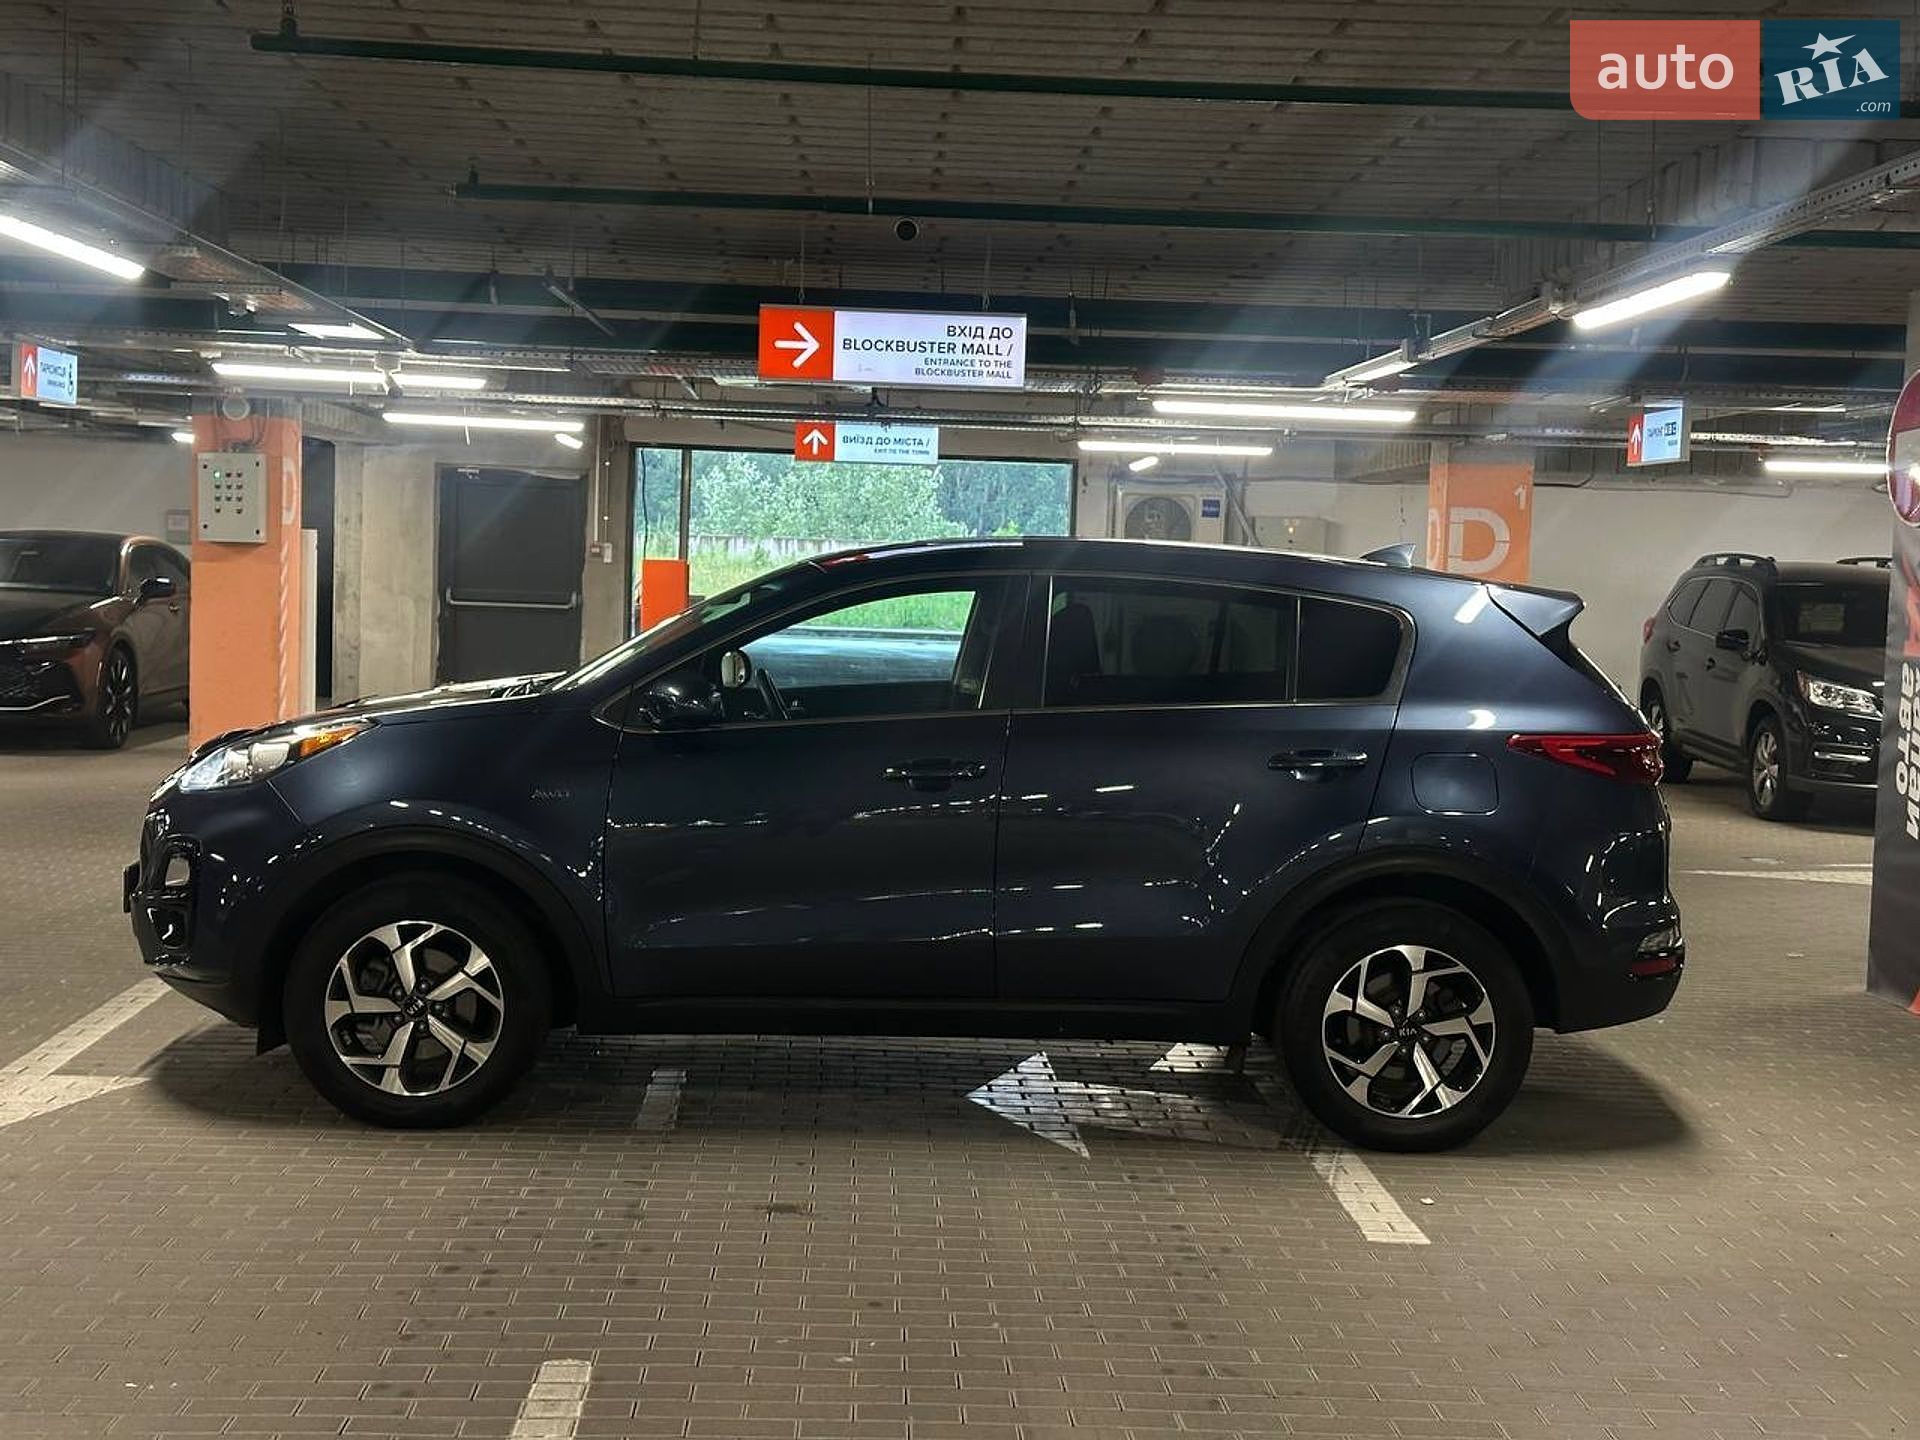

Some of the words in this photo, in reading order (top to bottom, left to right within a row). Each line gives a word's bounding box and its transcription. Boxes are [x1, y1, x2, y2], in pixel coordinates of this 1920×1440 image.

[947, 325, 984, 339] ВХІД
[988, 327, 1013, 340] ДО
[842, 338, 957, 354] BLOCKBUSTER
[961, 343, 1003, 356] MALL
[924, 357, 976, 367] ENTRANCE
[978, 359, 991, 368] TO
[994, 360, 1013, 368] THE
[915, 367, 984, 378] BLOCKBUSTER
[985, 370, 1013, 379] MALL
[842, 434, 873, 445] ВИЇЗД
[875, 436, 891, 446] ДО
[893, 438, 924, 446] МІСТА
[1514, 484, 1527, 511] 1
[1447, 506, 1510, 576] D
